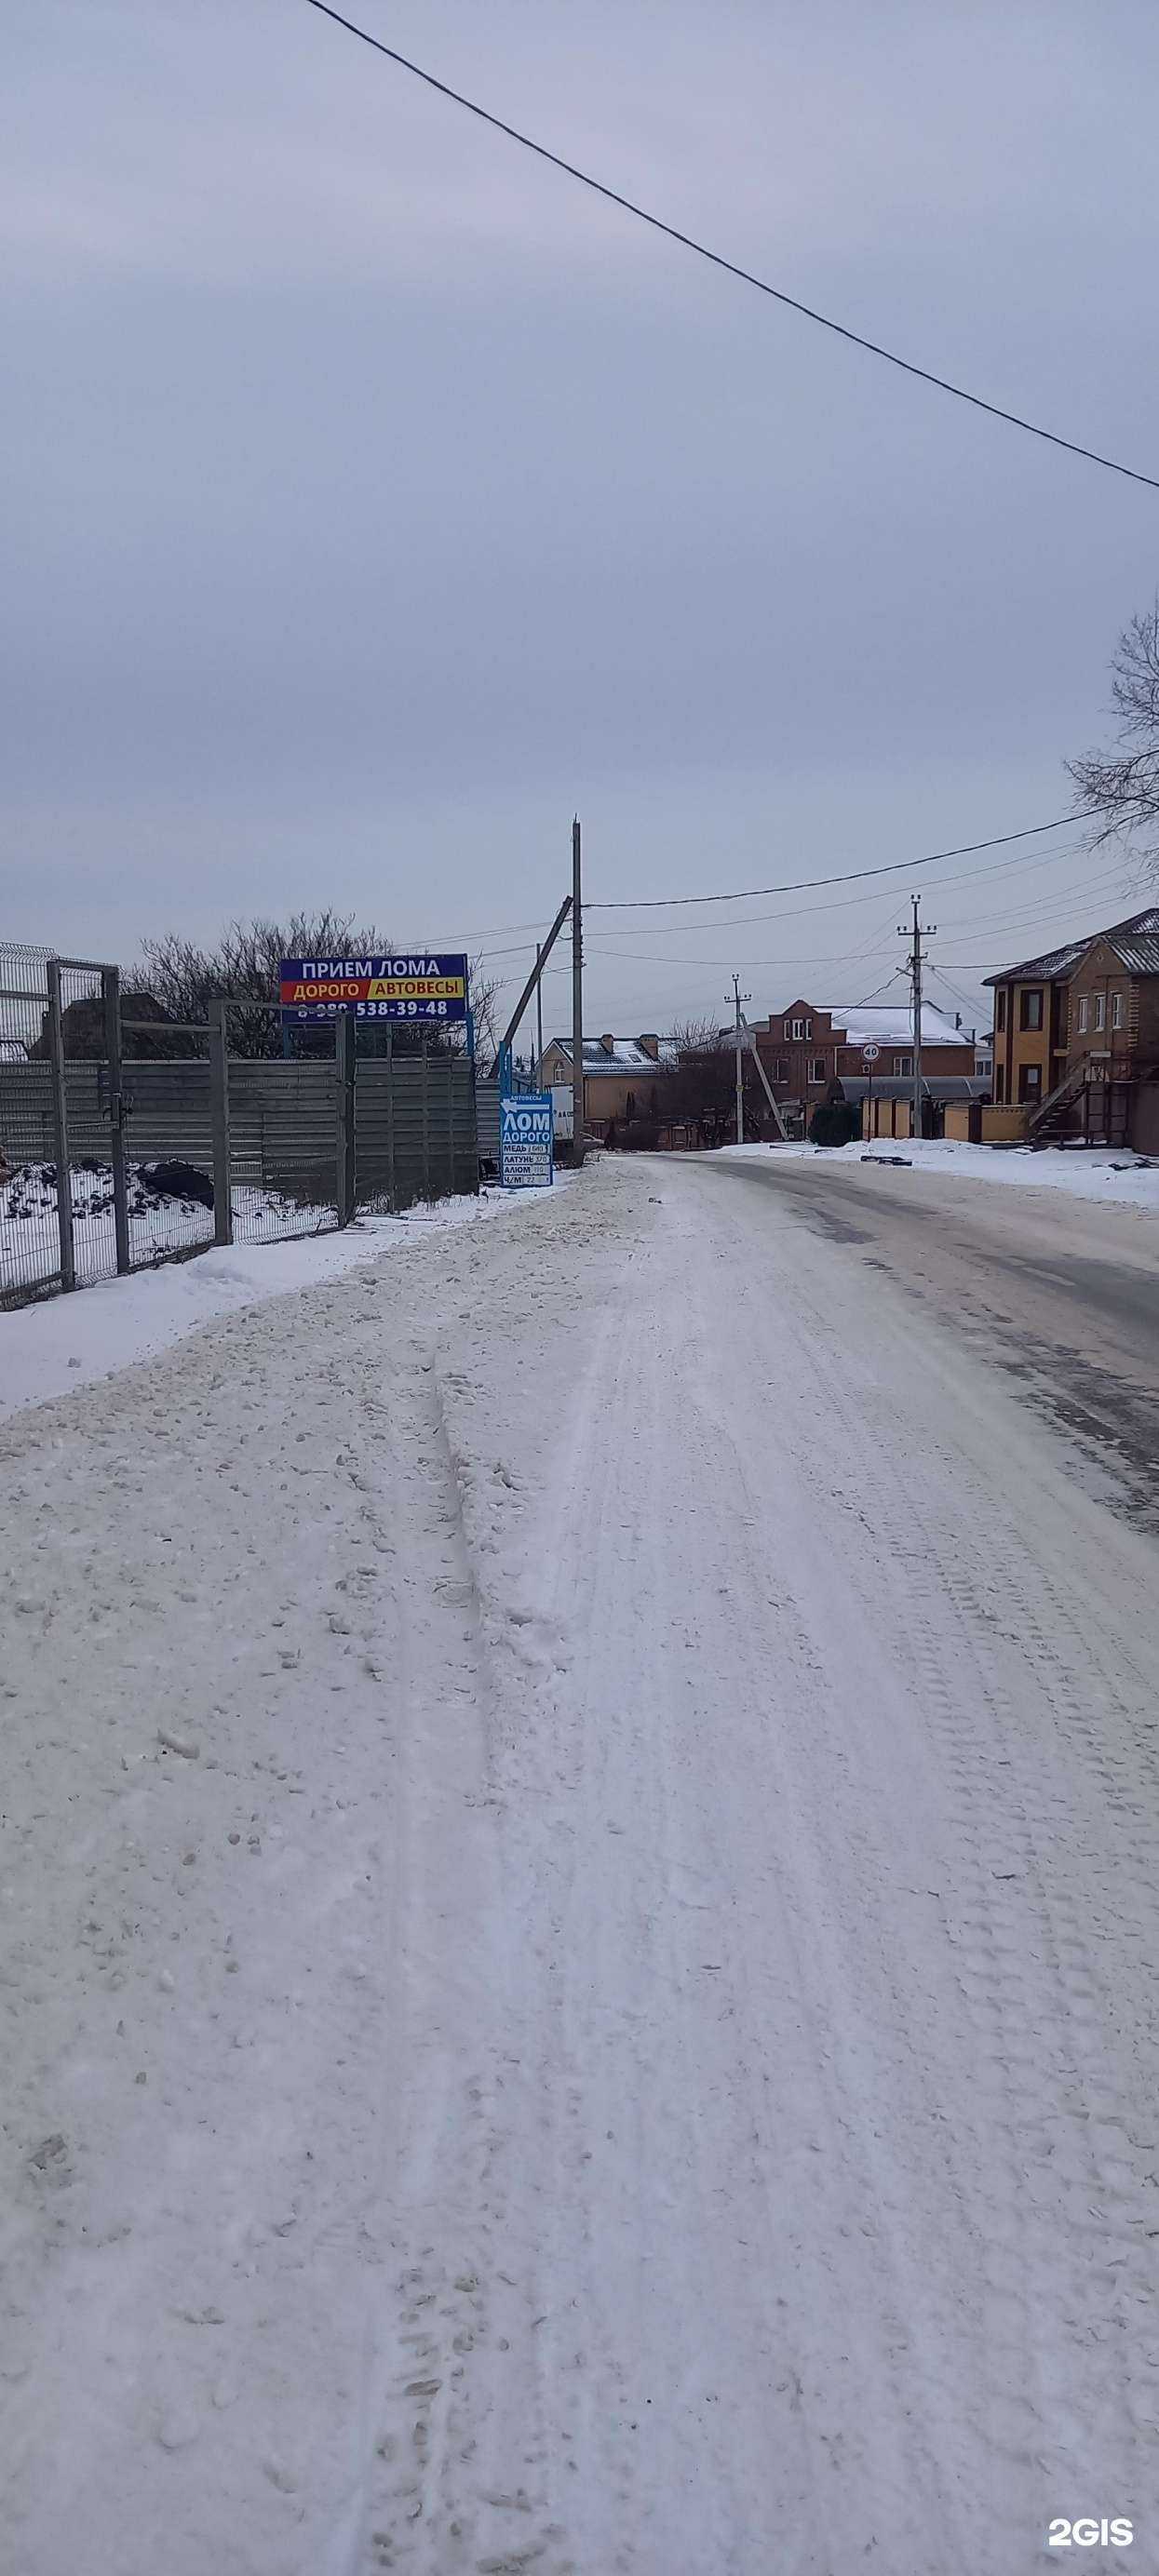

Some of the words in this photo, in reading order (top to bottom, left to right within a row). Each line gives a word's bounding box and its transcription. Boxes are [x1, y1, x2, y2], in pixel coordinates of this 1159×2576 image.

[303, 961, 372, 979] ПРИЕМ
[378, 959, 440, 976] ЛОМА
[293, 983, 359, 1001] ДОРОГО
[375, 980, 458, 996] АВТОВЕСЫ
[357, 1000, 448, 1016] 538-39-48
[865, 1048, 877, 1056] 40
[503, 1113, 550, 1132] ЛОМ
[503, 1132, 550, 1143] ДОРОГО
[504, 1145, 527, 1153] МЕДЬ
